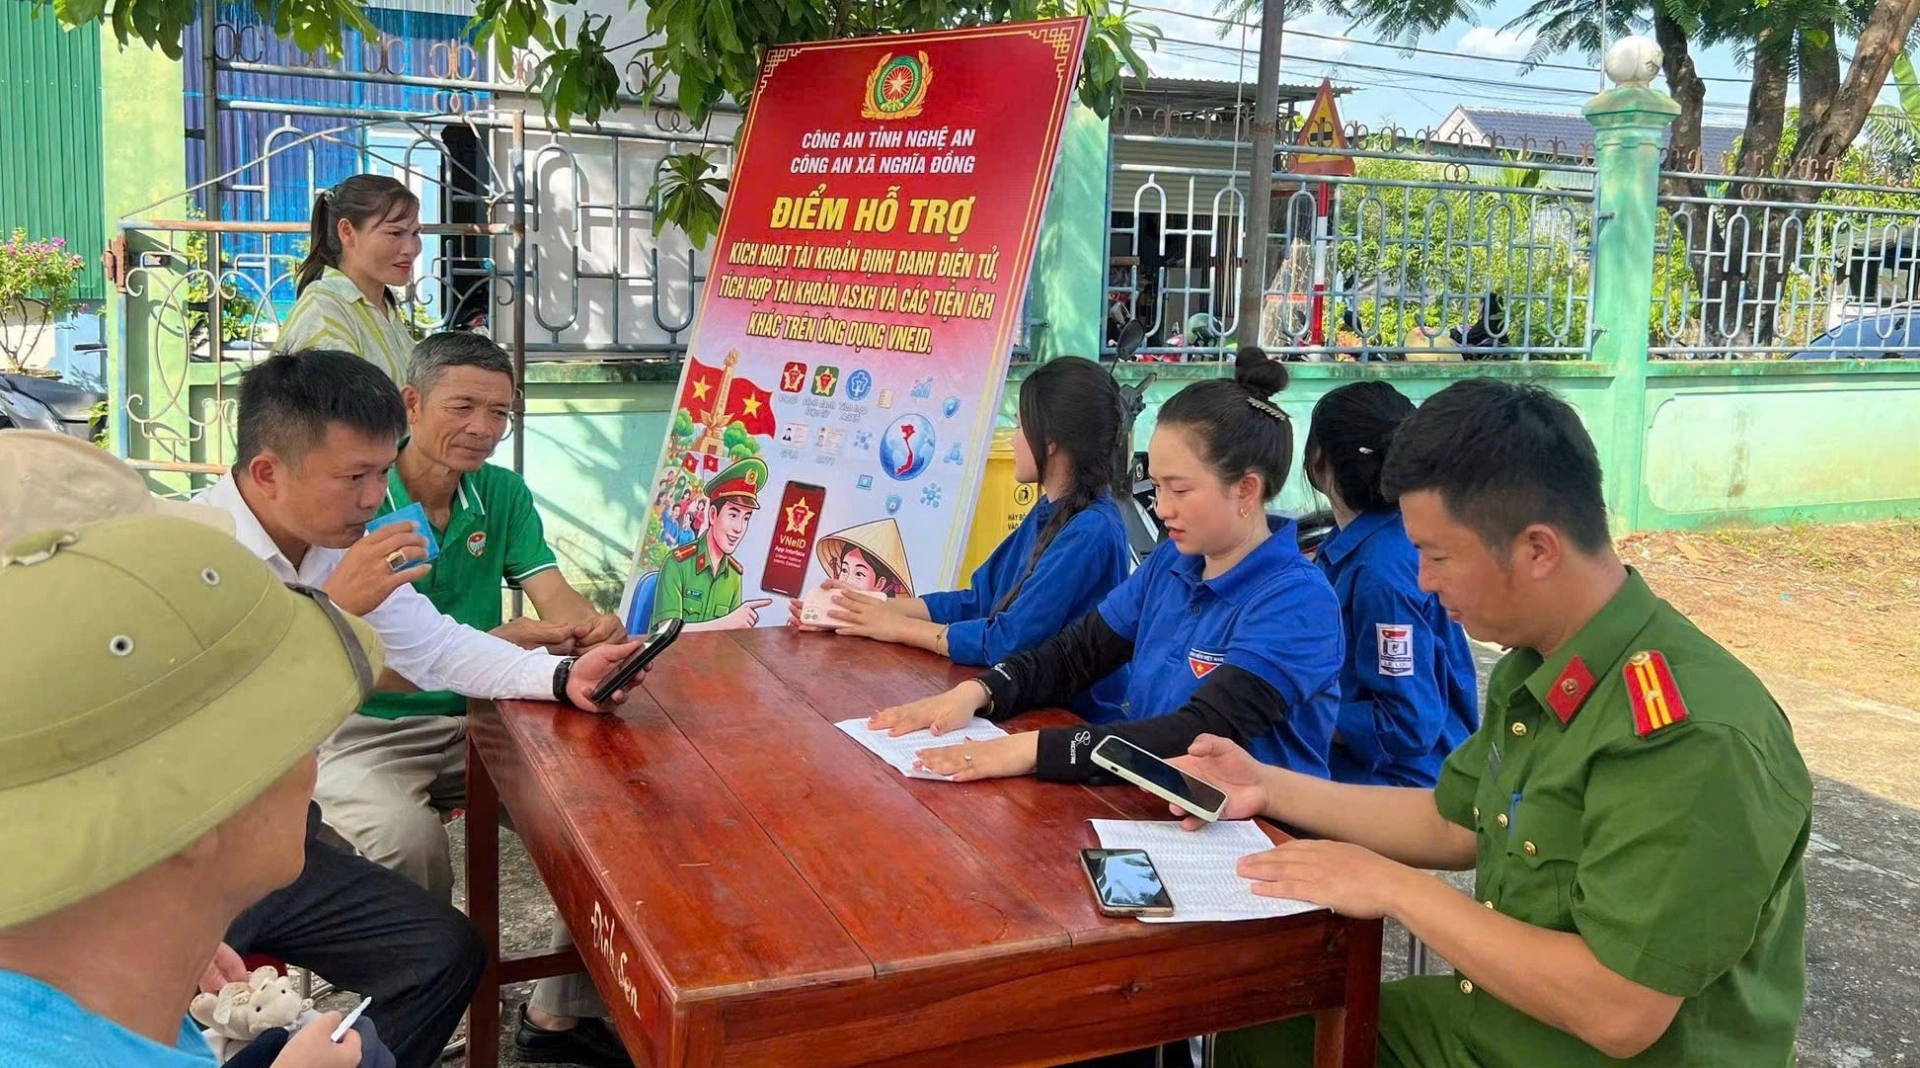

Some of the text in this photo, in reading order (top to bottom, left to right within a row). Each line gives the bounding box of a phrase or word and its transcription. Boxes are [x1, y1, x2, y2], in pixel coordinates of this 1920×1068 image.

[802, 125, 976, 150] CÔNG AN TỈNH NGHỆ AN
[790, 150, 975, 174] CÔNG AN XÃ NGHĨA ĐỒNG
[770, 183, 977, 244] ĐIỂM HỖ TRỢ
[728, 238, 1000, 283] KÍCH HOẠT TÀI KHOẢN ĐỊNH DANH ĐIỆN TỬ,
[718, 271, 995, 320] TÍCH HỢP TÀI KHOẢN ASXH VÀ CÁC TIỆN ÍCH
[746, 309, 933, 354] KHÁC TRÊN ỨNG DỤNG VNEID.
